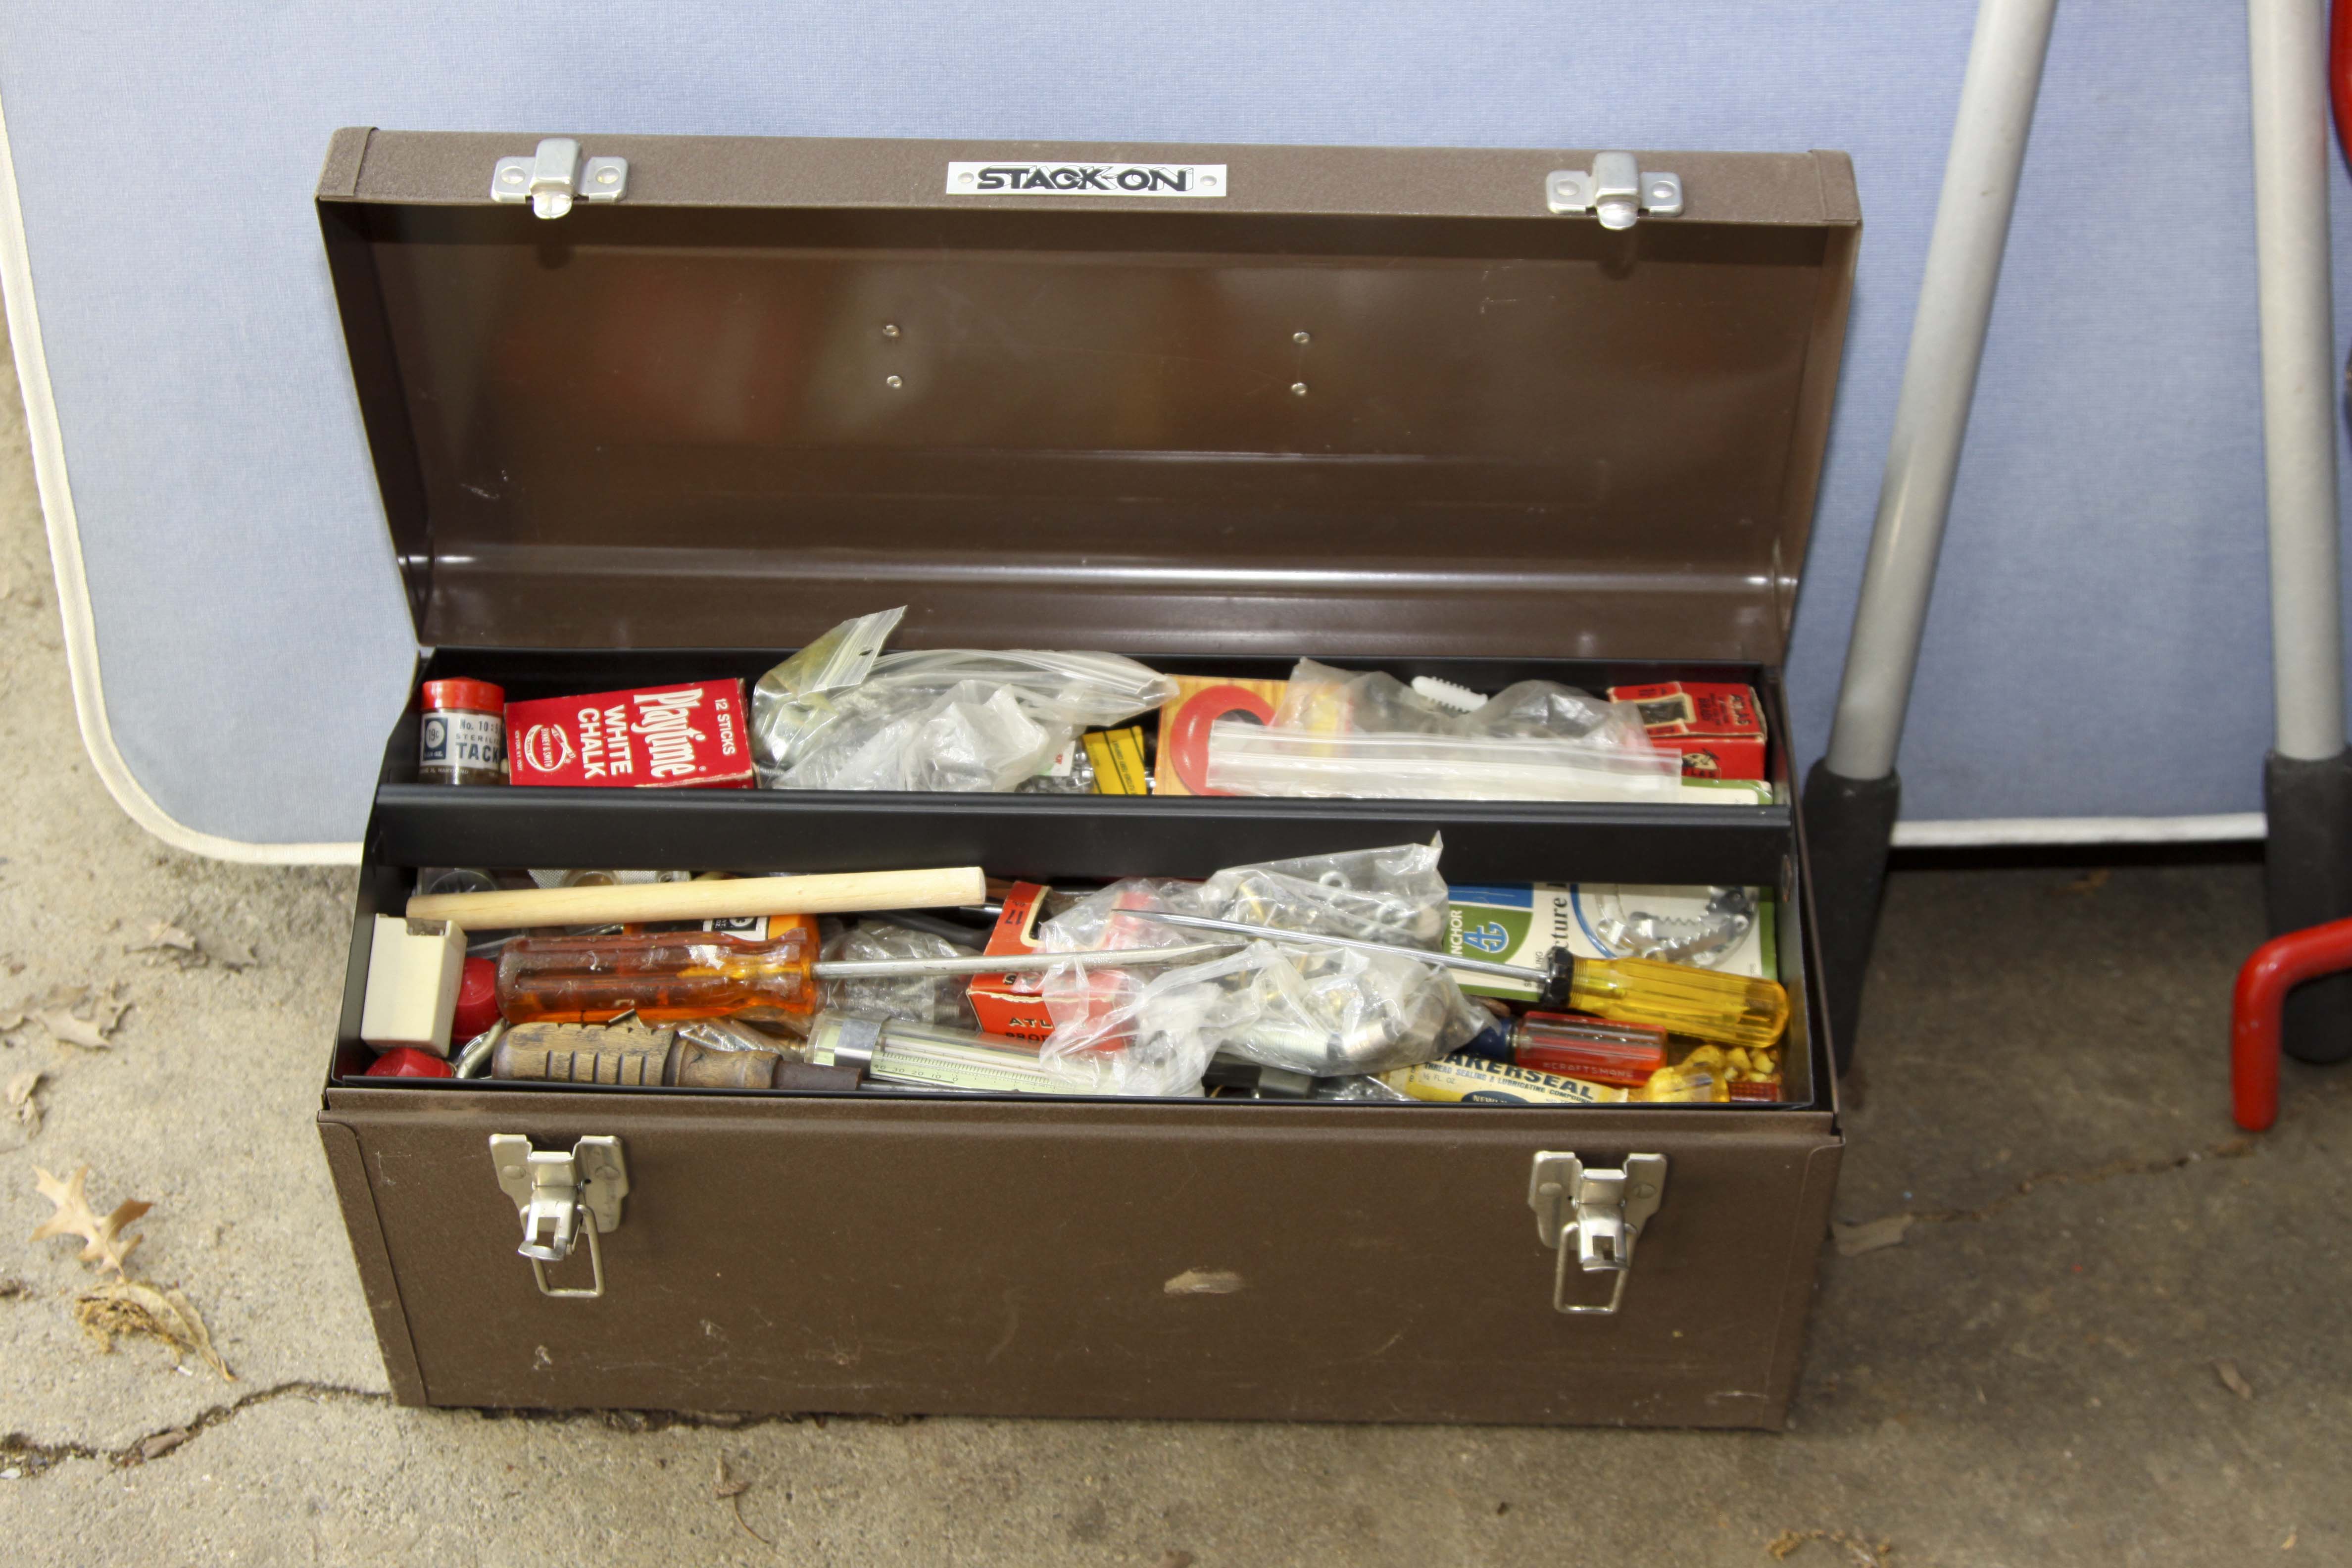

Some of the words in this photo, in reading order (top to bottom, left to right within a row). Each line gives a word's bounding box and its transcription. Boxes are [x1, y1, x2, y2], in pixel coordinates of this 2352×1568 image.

[977, 164, 1194, 191] STACK-ON
[715, 698, 728, 711] 12
[459, 718, 474, 730] No.
[540, 728, 550, 746] BINNEY
[603, 704, 633, 776] WHITE
[630, 687, 706, 778] Playtime
[717, 713, 736, 755] STICKS
[543, 751, 553, 768] SMITH
[578, 708, 606, 779] CHALK
[1005, 909, 1025, 925] 17
[1450, 909, 1463, 957] NCHOR
[1549, 896, 1569, 949] cture
[1424, 1064, 1453, 1074] THREAD
[1456, 1068, 1487, 1081] SEALING
[1497, 1076, 1546, 1093] LUBRICATING
[1443, 1053, 1594, 1100] AKERSEAL
